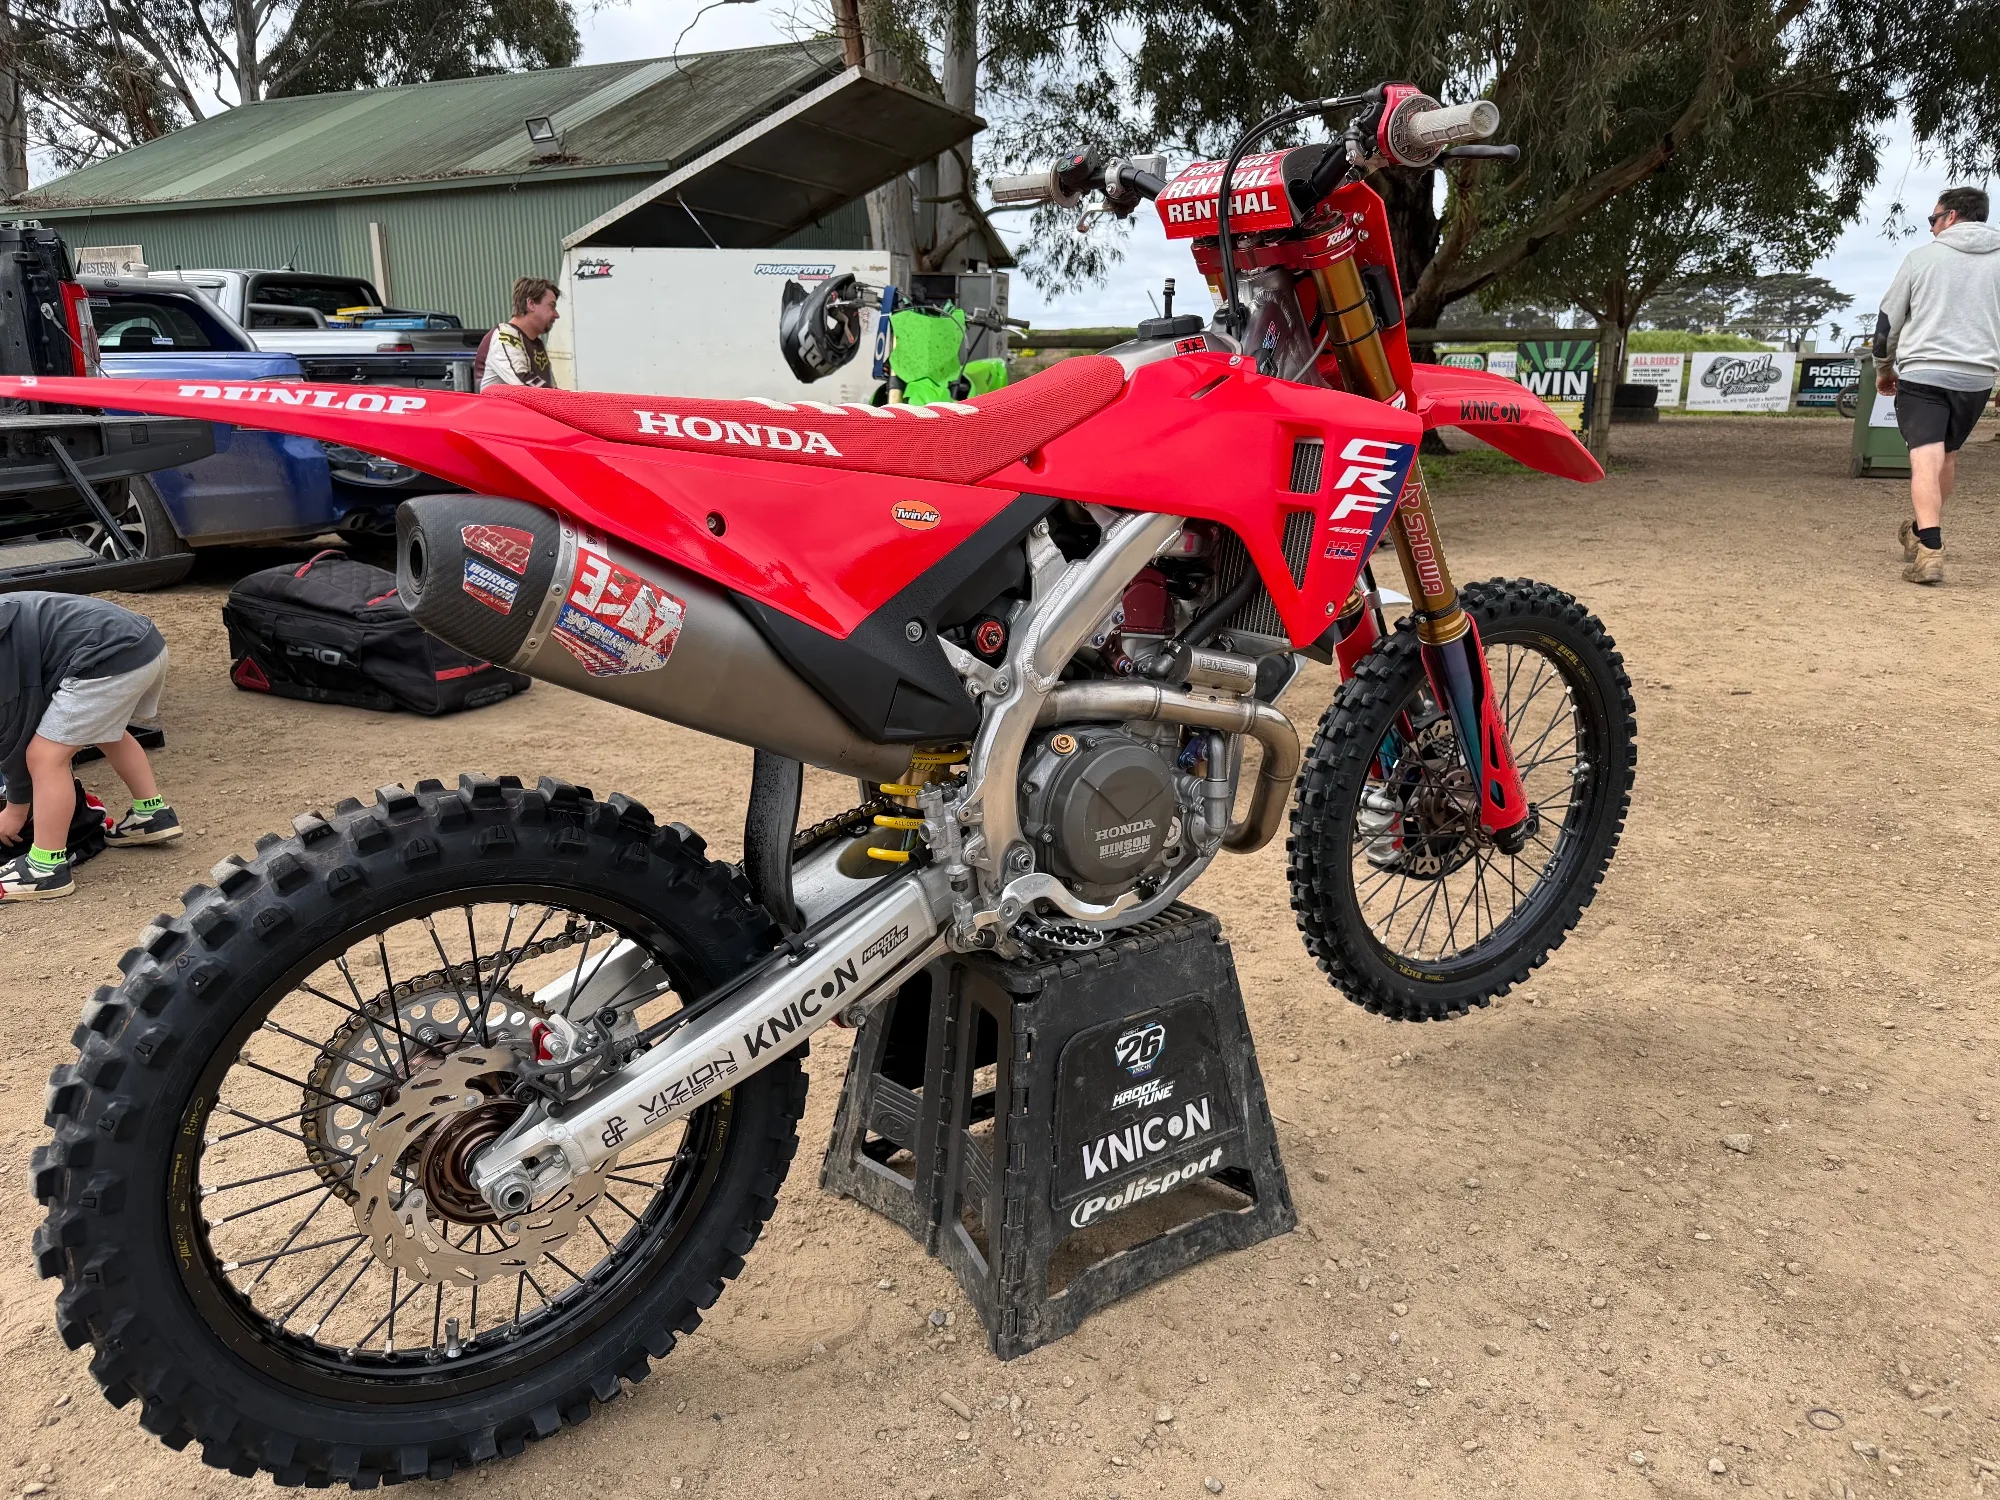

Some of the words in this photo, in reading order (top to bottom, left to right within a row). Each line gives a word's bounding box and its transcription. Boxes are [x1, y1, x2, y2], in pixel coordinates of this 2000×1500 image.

[1183, 154, 1277, 177] RENHAL
[755, 264, 835, 275] POWERSPORTS
[1175, 336, 1206, 352] ETS
[1490, 360, 1516, 368] WESTE
[1633, 357, 1648, 366] ALL
[1650, 357, 1680, 366] RIDERS
[1714, 354, 1773, 388] Towan
[1519, 371, 1588, 395] WIN
[178, 385, 427, 414] DUNLOP
[1460, 400, 1521, 424] KNICON
[633, 410, 843, 457] HONDA
[1328, 438, 1404, 520] CRF
[895, 507, 922, 521] Twin
[922, 509, 938, 522] Air
[1328, 526, 1373, 537] 450R
[1325, 541, 1362, 558] HRC
[1403, 512, 1445, 597] SHOWA
[468, 562, 518, 591] WORKS
[470, 574, 513, 600] EDITION
[1557, 645, 1579, 666] EXCEL
[1094, 819, 1156, 841] HONDA
[1100, 834, 1151, 856] HINSON
[880, 929, 909, 957] TUNE
[743, 958, 859, 1058] KNICON
[1120, 1028, 1162, 1068] 26
[638, 1051, 736, 1113] VIZION
[643, 1064, 739, 1125] CONCEPTS
[1137, 1085, 1174, 1109] TUNE
[1082, 1097, 1212, 1181] KNICON
[1078, 1147, 1223, 1225] Polisport
